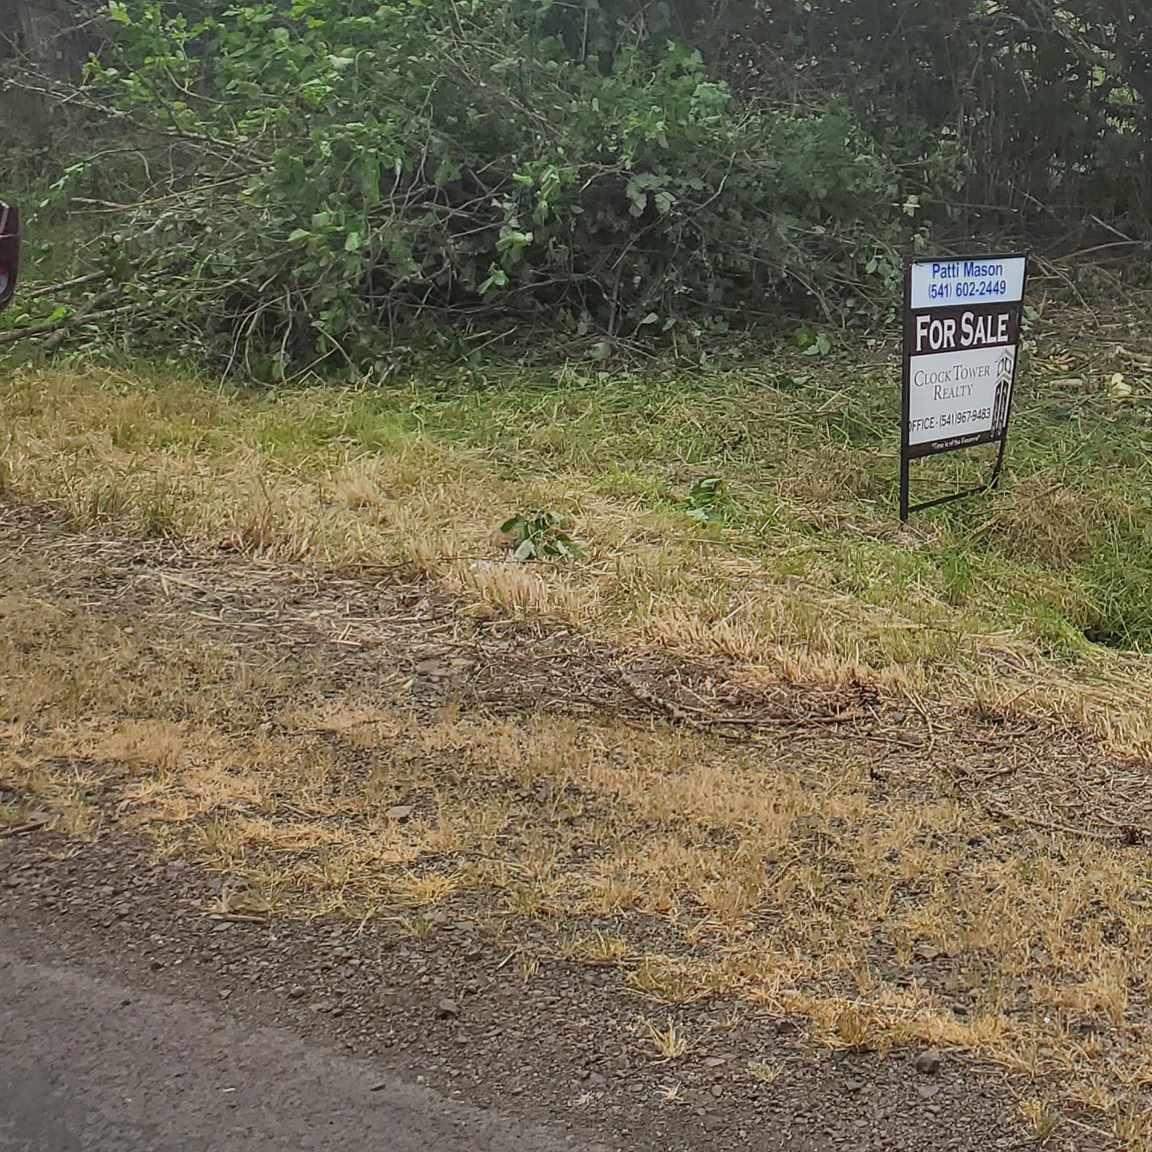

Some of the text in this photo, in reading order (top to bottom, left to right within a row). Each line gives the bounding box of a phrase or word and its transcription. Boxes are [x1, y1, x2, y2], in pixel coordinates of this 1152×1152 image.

[932, 261, 1003, 279] Patti Mason
[928, 280, 1007, 299] (541) 602-2449
[916, 311, 1009, 352] FOR SALE
[913, 364, 990, 388] CLOCK TOWER
[933, 384, 974, 401] REALTY
